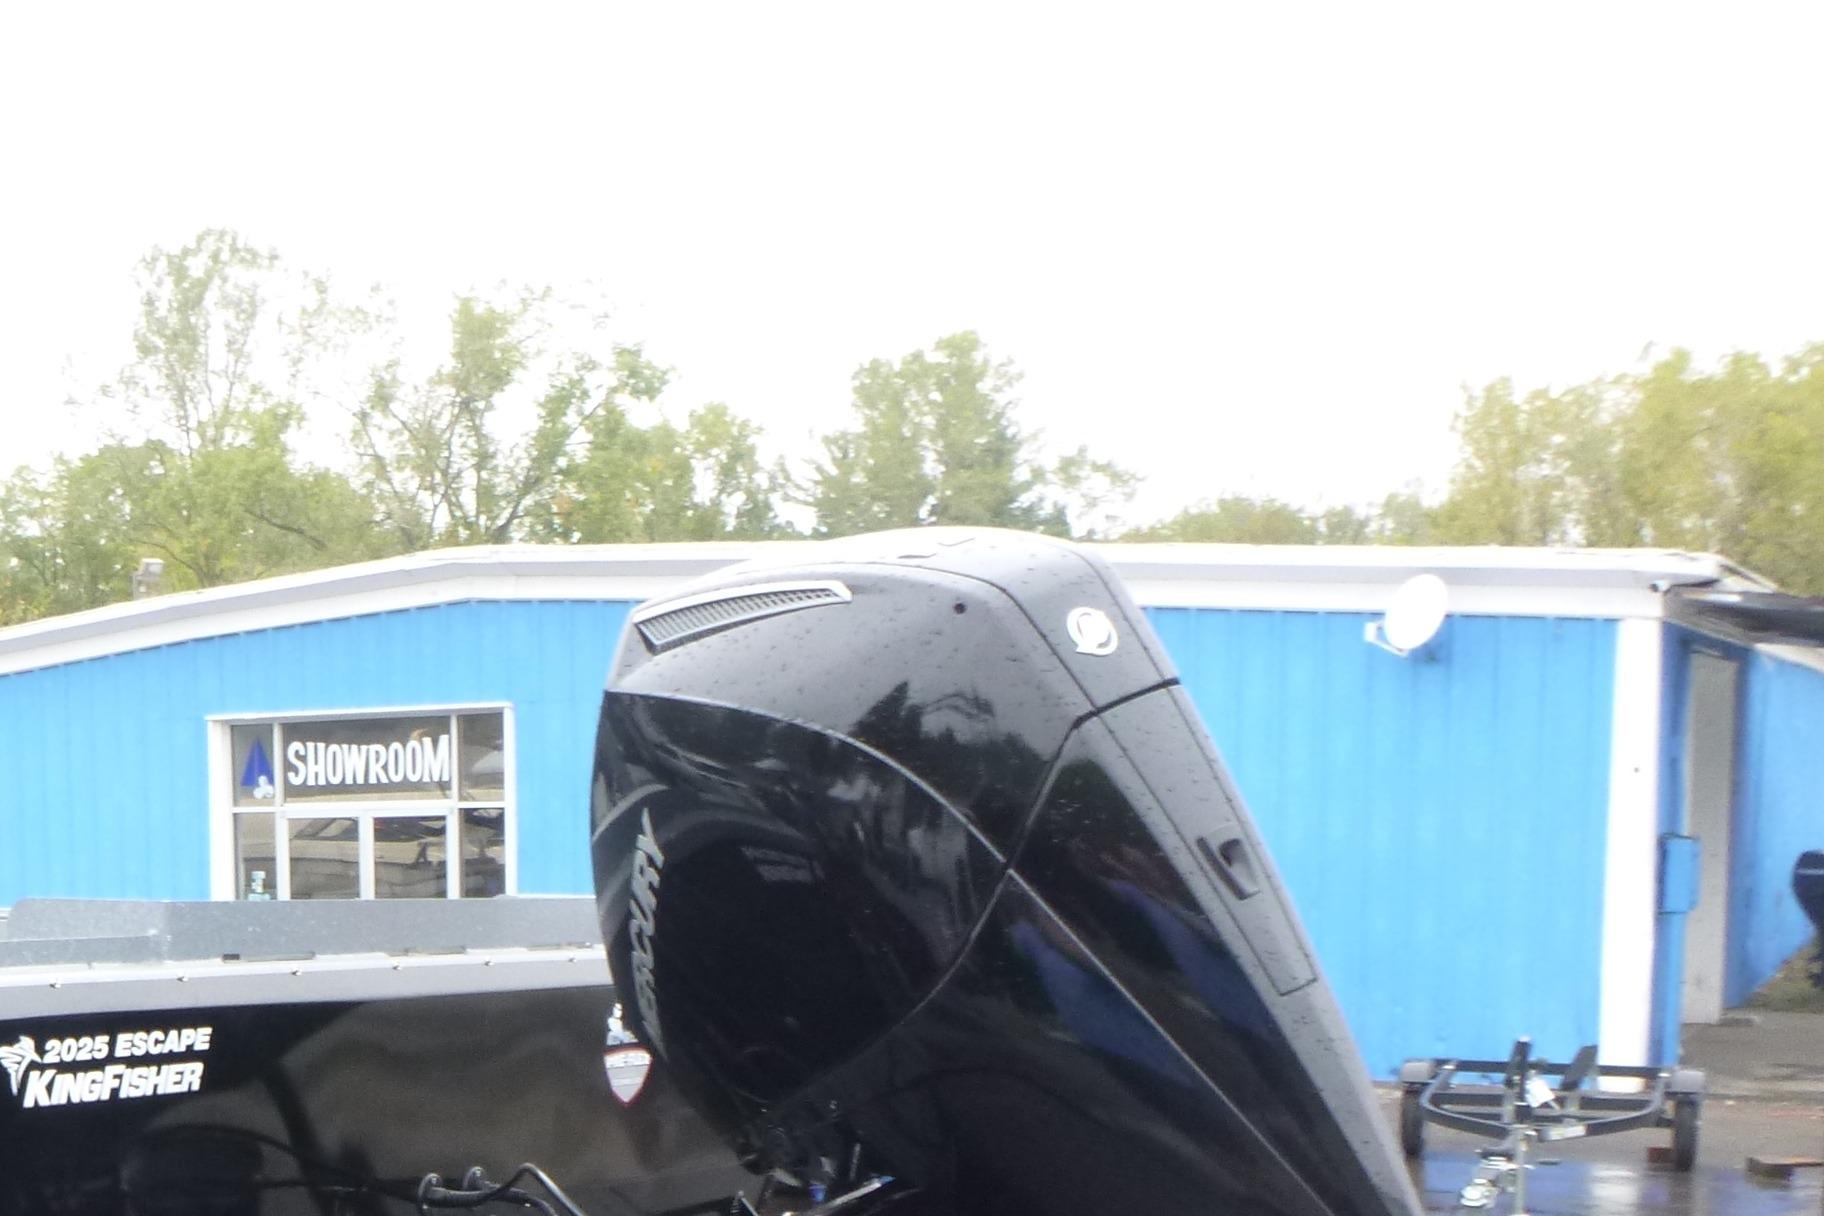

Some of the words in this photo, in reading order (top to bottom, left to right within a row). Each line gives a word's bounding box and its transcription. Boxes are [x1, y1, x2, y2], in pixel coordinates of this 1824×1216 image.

[287, 733, 451, 786] SHOWROOM
[42, 1035, 110, 1064] 2025
[114, 1026, 213, 1058] ESCAPE
[22, 1061, 205, 1109] KINGFISHER
